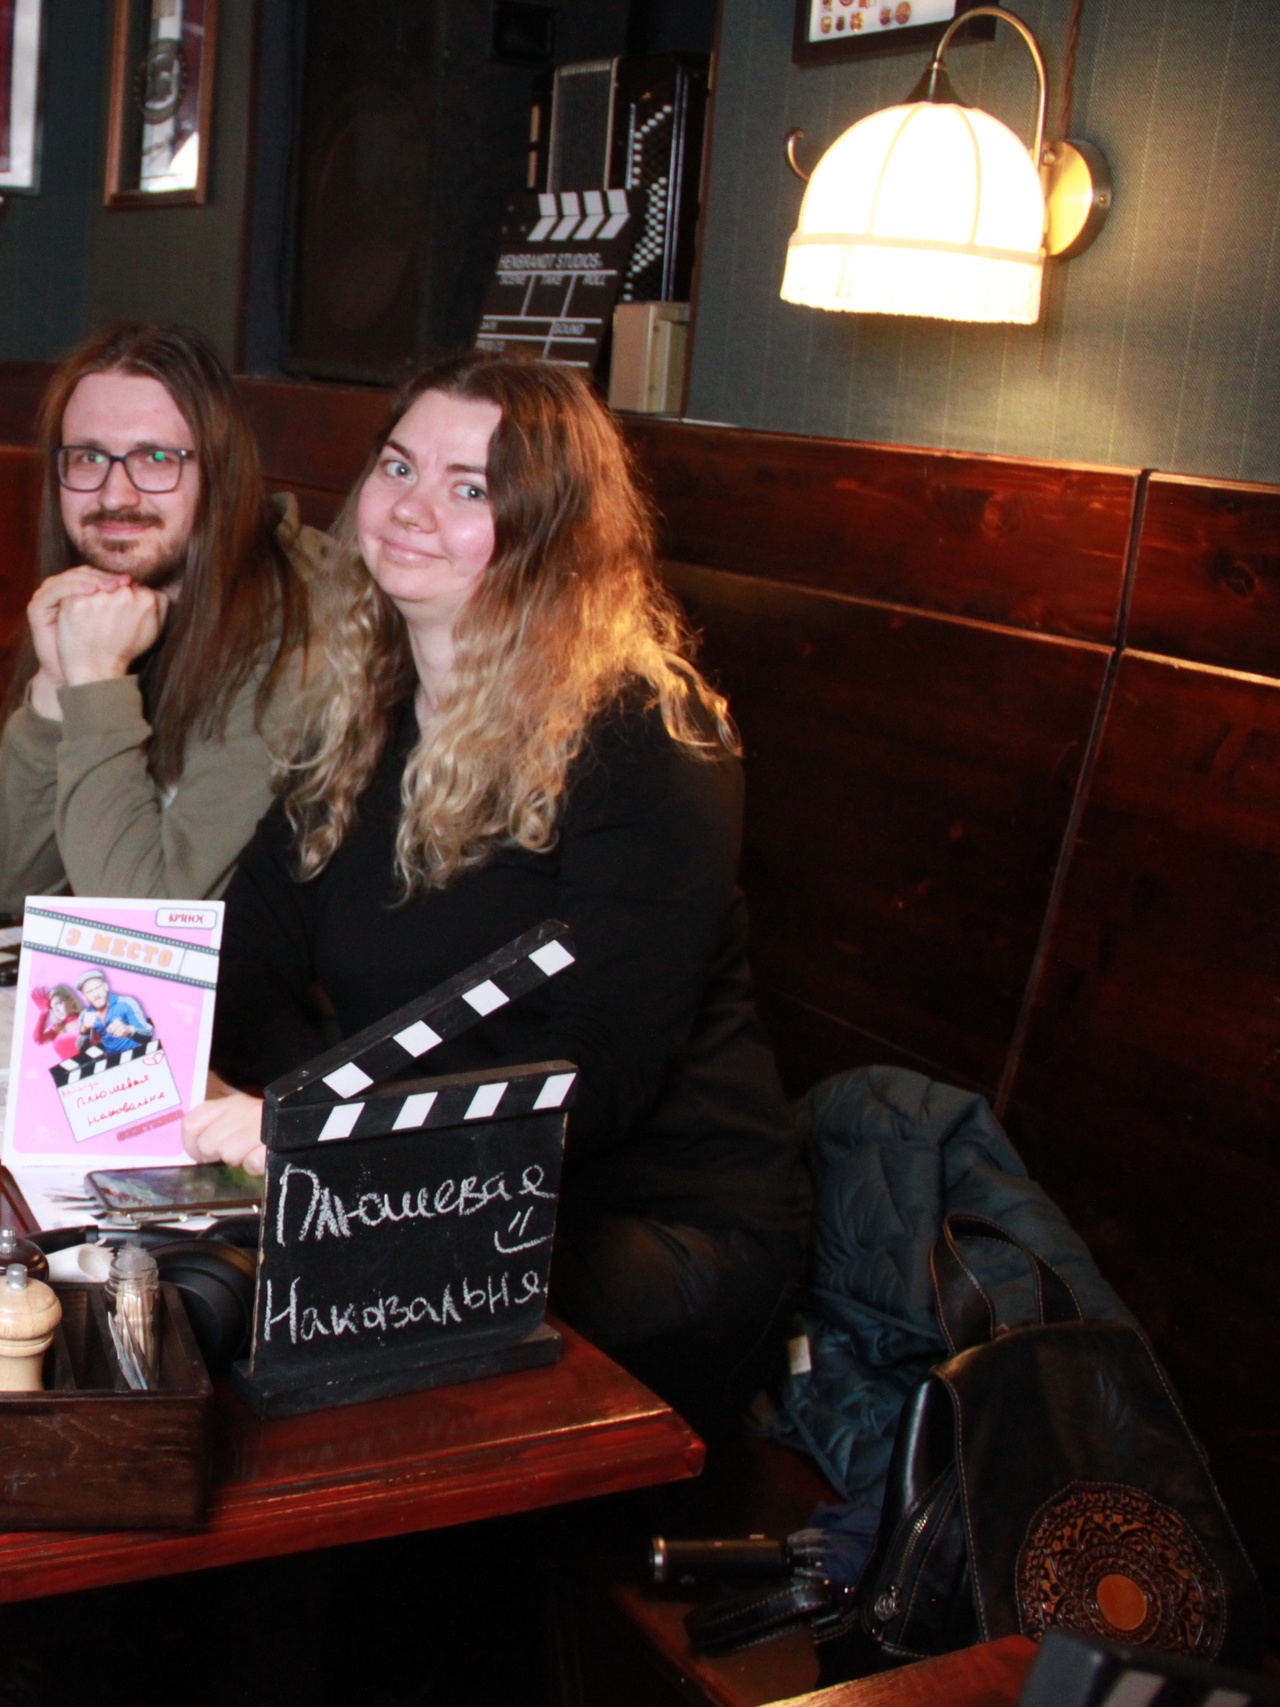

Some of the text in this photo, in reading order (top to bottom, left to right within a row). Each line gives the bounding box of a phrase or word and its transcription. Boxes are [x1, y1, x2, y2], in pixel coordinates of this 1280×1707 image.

[582, 275, 606, 286] ROLL
[92, 934, 173, 967] МЕСТО
[276, 1163, 558, 1247] Плюшевая
